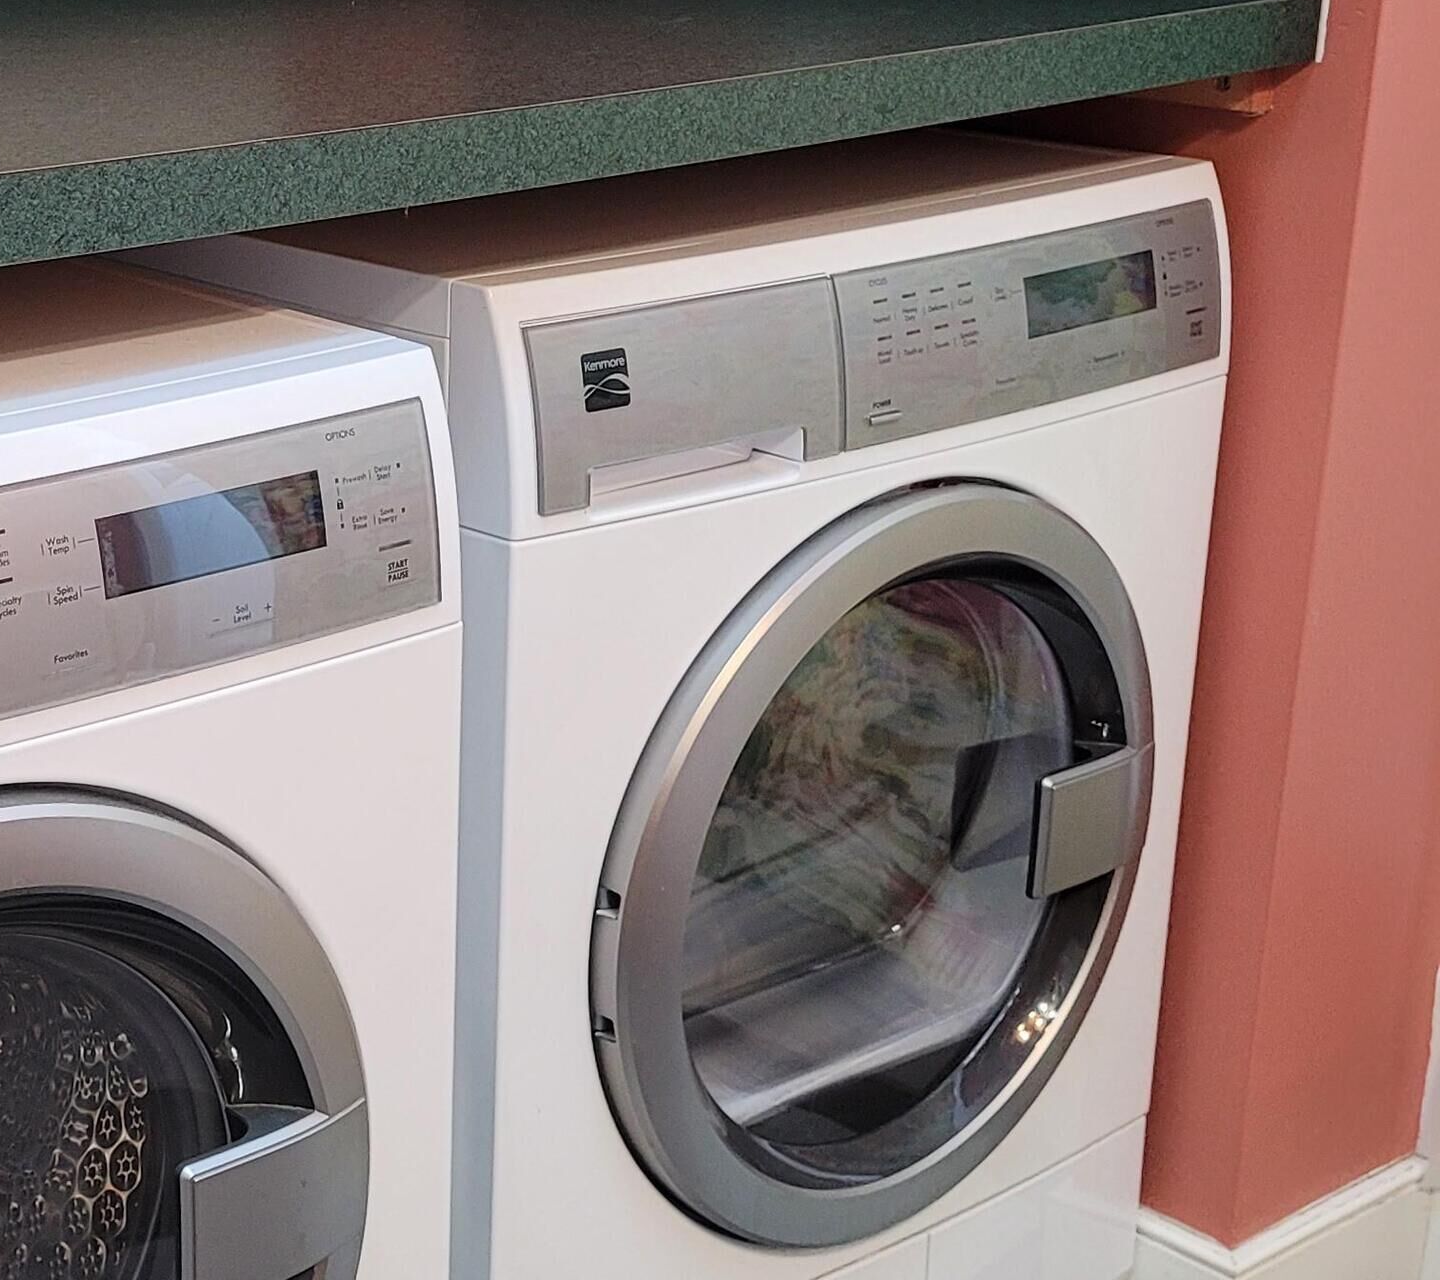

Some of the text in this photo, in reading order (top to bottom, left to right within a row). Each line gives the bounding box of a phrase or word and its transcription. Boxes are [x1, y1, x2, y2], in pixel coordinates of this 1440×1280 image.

[584, 357, 625, 372] Kenmore
[325, 428, 355, 441] OPTIONS
[45, 536, 69, 546] Wash
[48, 546, 69, 555] Temp
[388, 559, 408, 570] START
[388, 571, 409, 582] PAUSE
[56, 585, 73, 596] Spin
[53, 594, 78, 605] Speed
[236, 604, 249, 614] Soil
[234, 612, 251, 623] Level
[54, 649, 88, 664] Favorites
